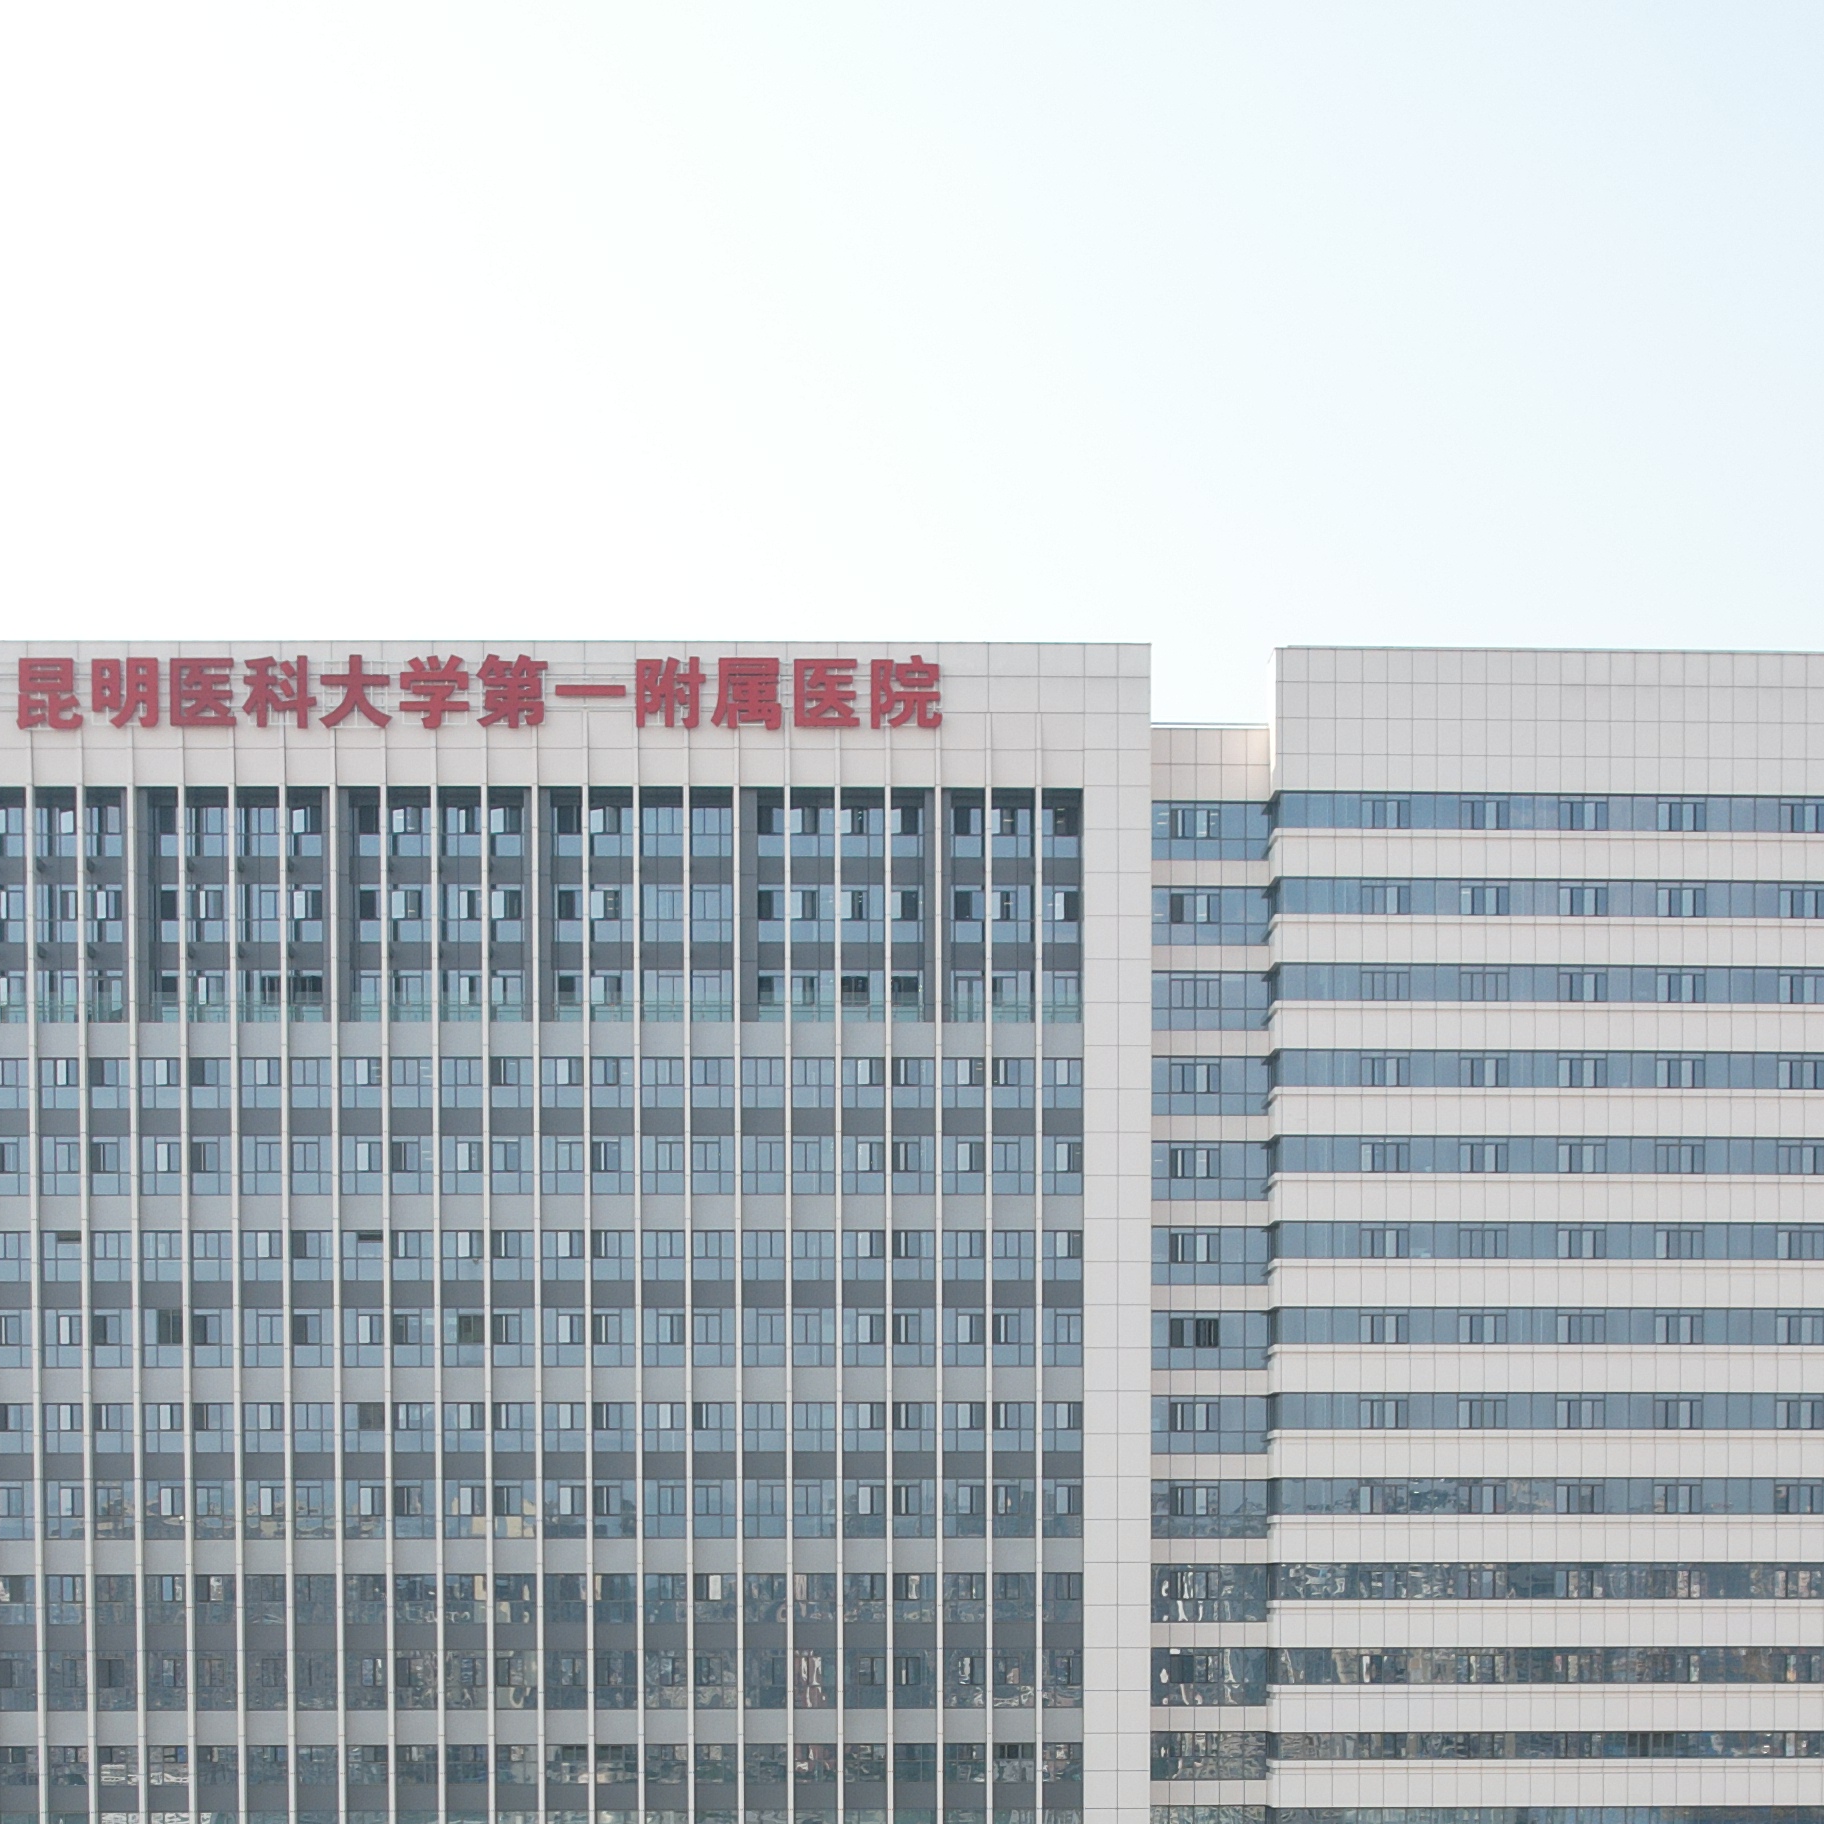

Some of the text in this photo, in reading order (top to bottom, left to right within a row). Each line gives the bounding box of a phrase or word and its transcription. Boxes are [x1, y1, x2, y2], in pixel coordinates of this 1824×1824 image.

[14, 654, 945, 731] 昆明医科大学第一附属医院
